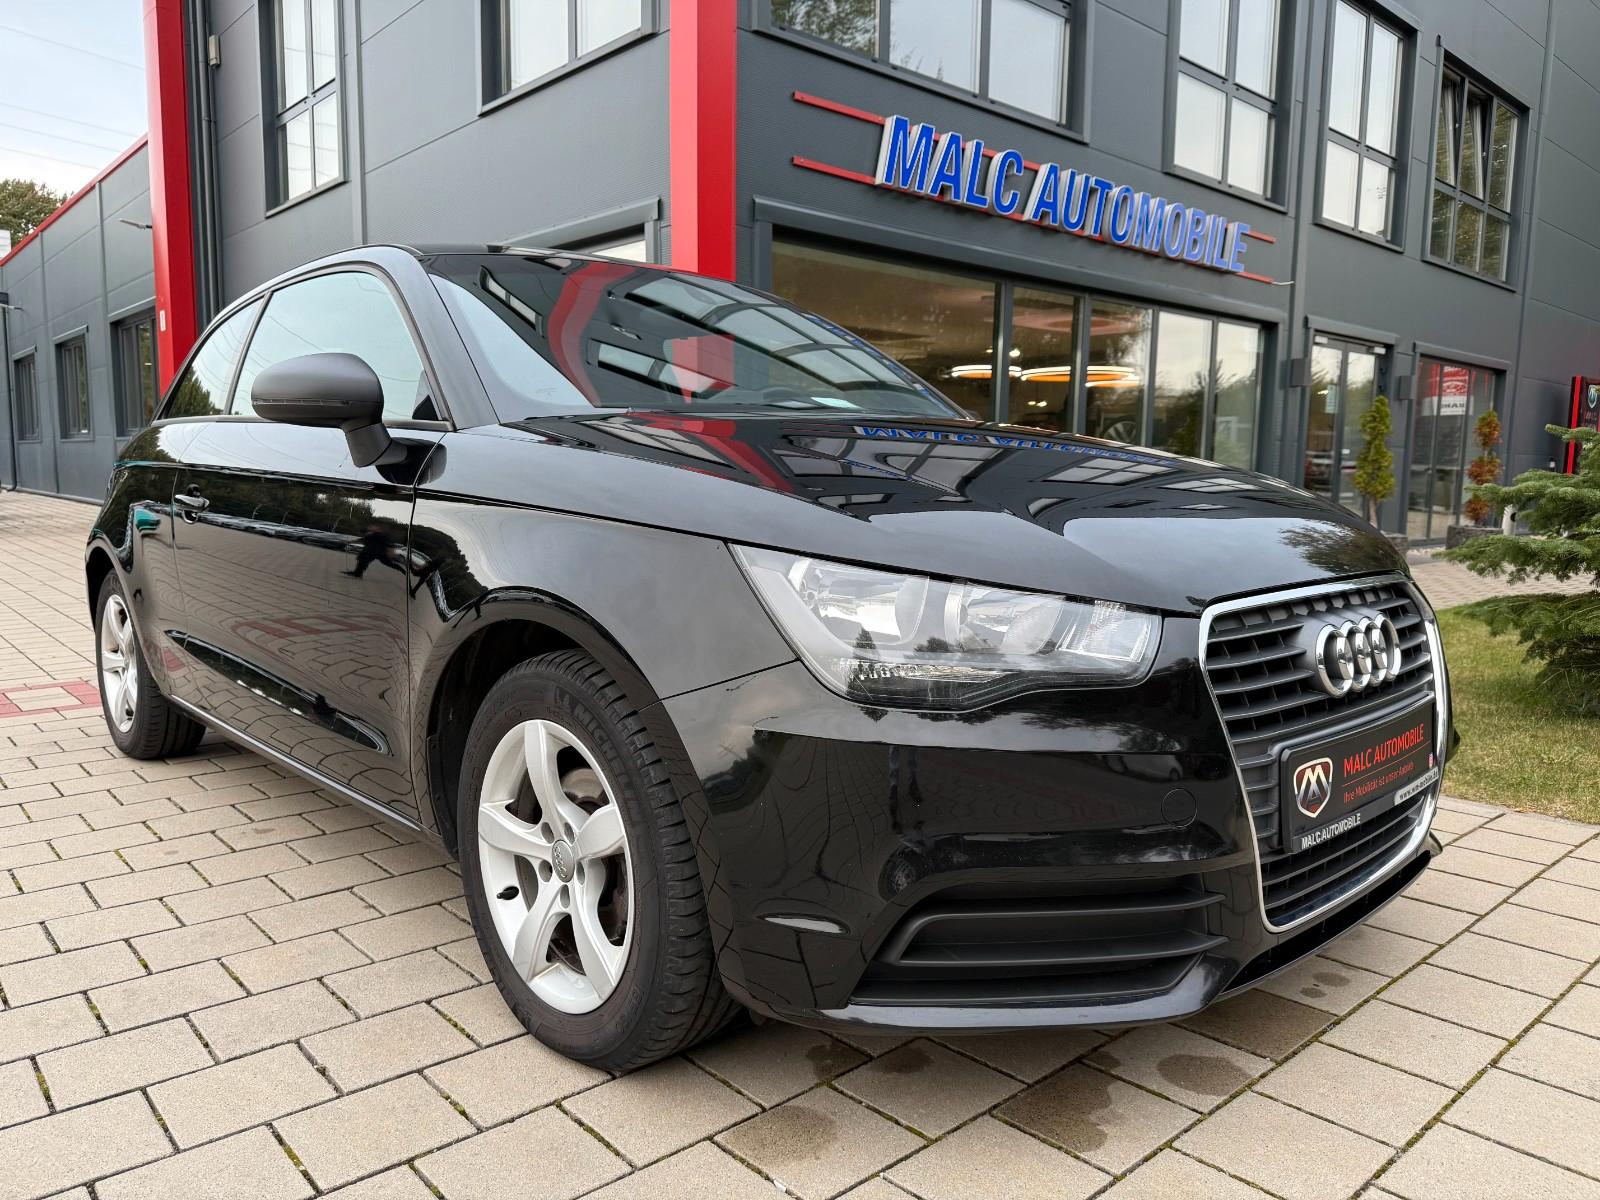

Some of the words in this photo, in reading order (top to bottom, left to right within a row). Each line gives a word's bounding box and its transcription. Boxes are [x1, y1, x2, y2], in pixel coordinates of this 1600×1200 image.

[877, 115, 1024, 215] MALC
[1024, 162, 1251, 273] AUTOMOBILE
[1343, 748, 1372, 777] MALC
[1373, 723, 1424, 765] AUTOMOBILE
[1321, 813, 1361, 841] AUTOMOBILE
